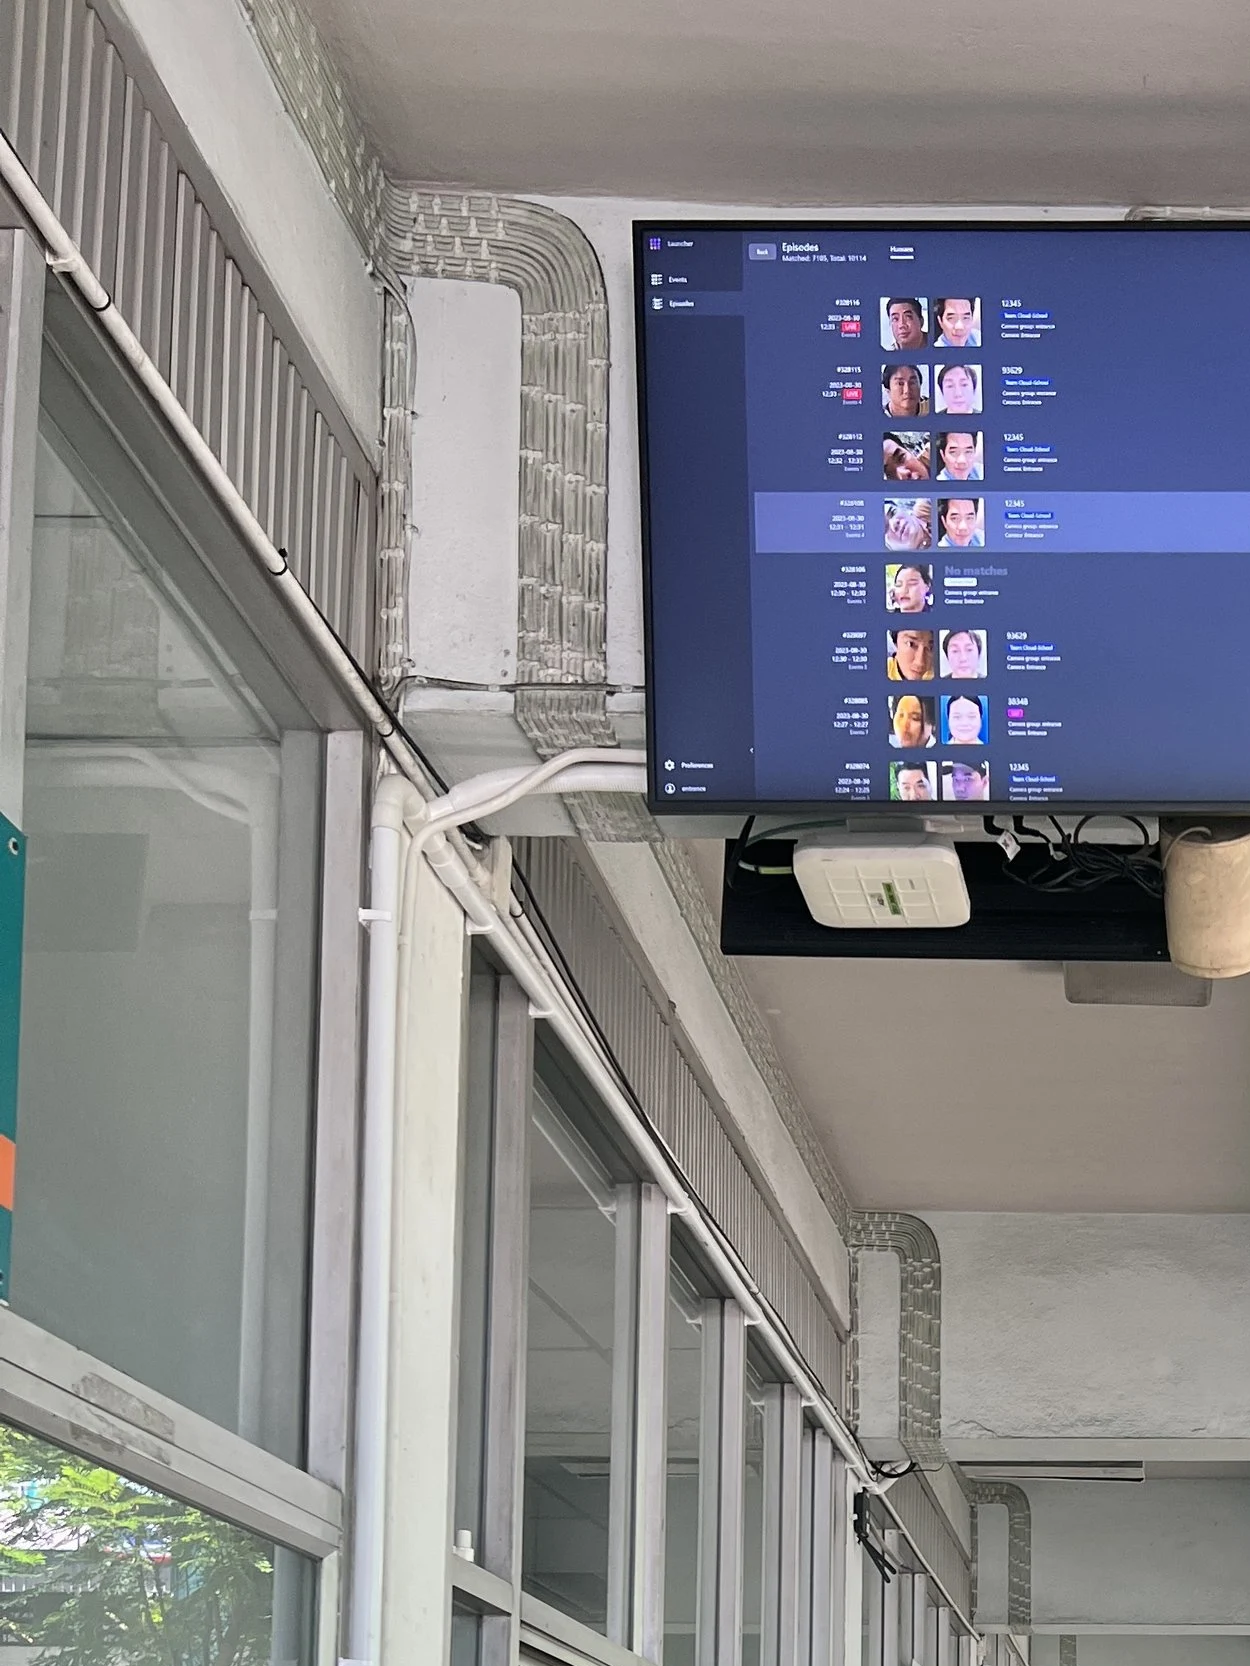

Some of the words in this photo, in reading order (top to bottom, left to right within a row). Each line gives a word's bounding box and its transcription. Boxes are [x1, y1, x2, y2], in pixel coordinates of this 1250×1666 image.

[782, 243, 819, 253] Episodes
[1001, 299, 1022, 308] 12345
[1003, 433, 1024, 441] 12345
[1005, 499, 1025, 508] 12345
[945, 566, 961, 576] No
[963, 566, 1008, 576] matches
[1009, 763, 1030, 771] 12345
